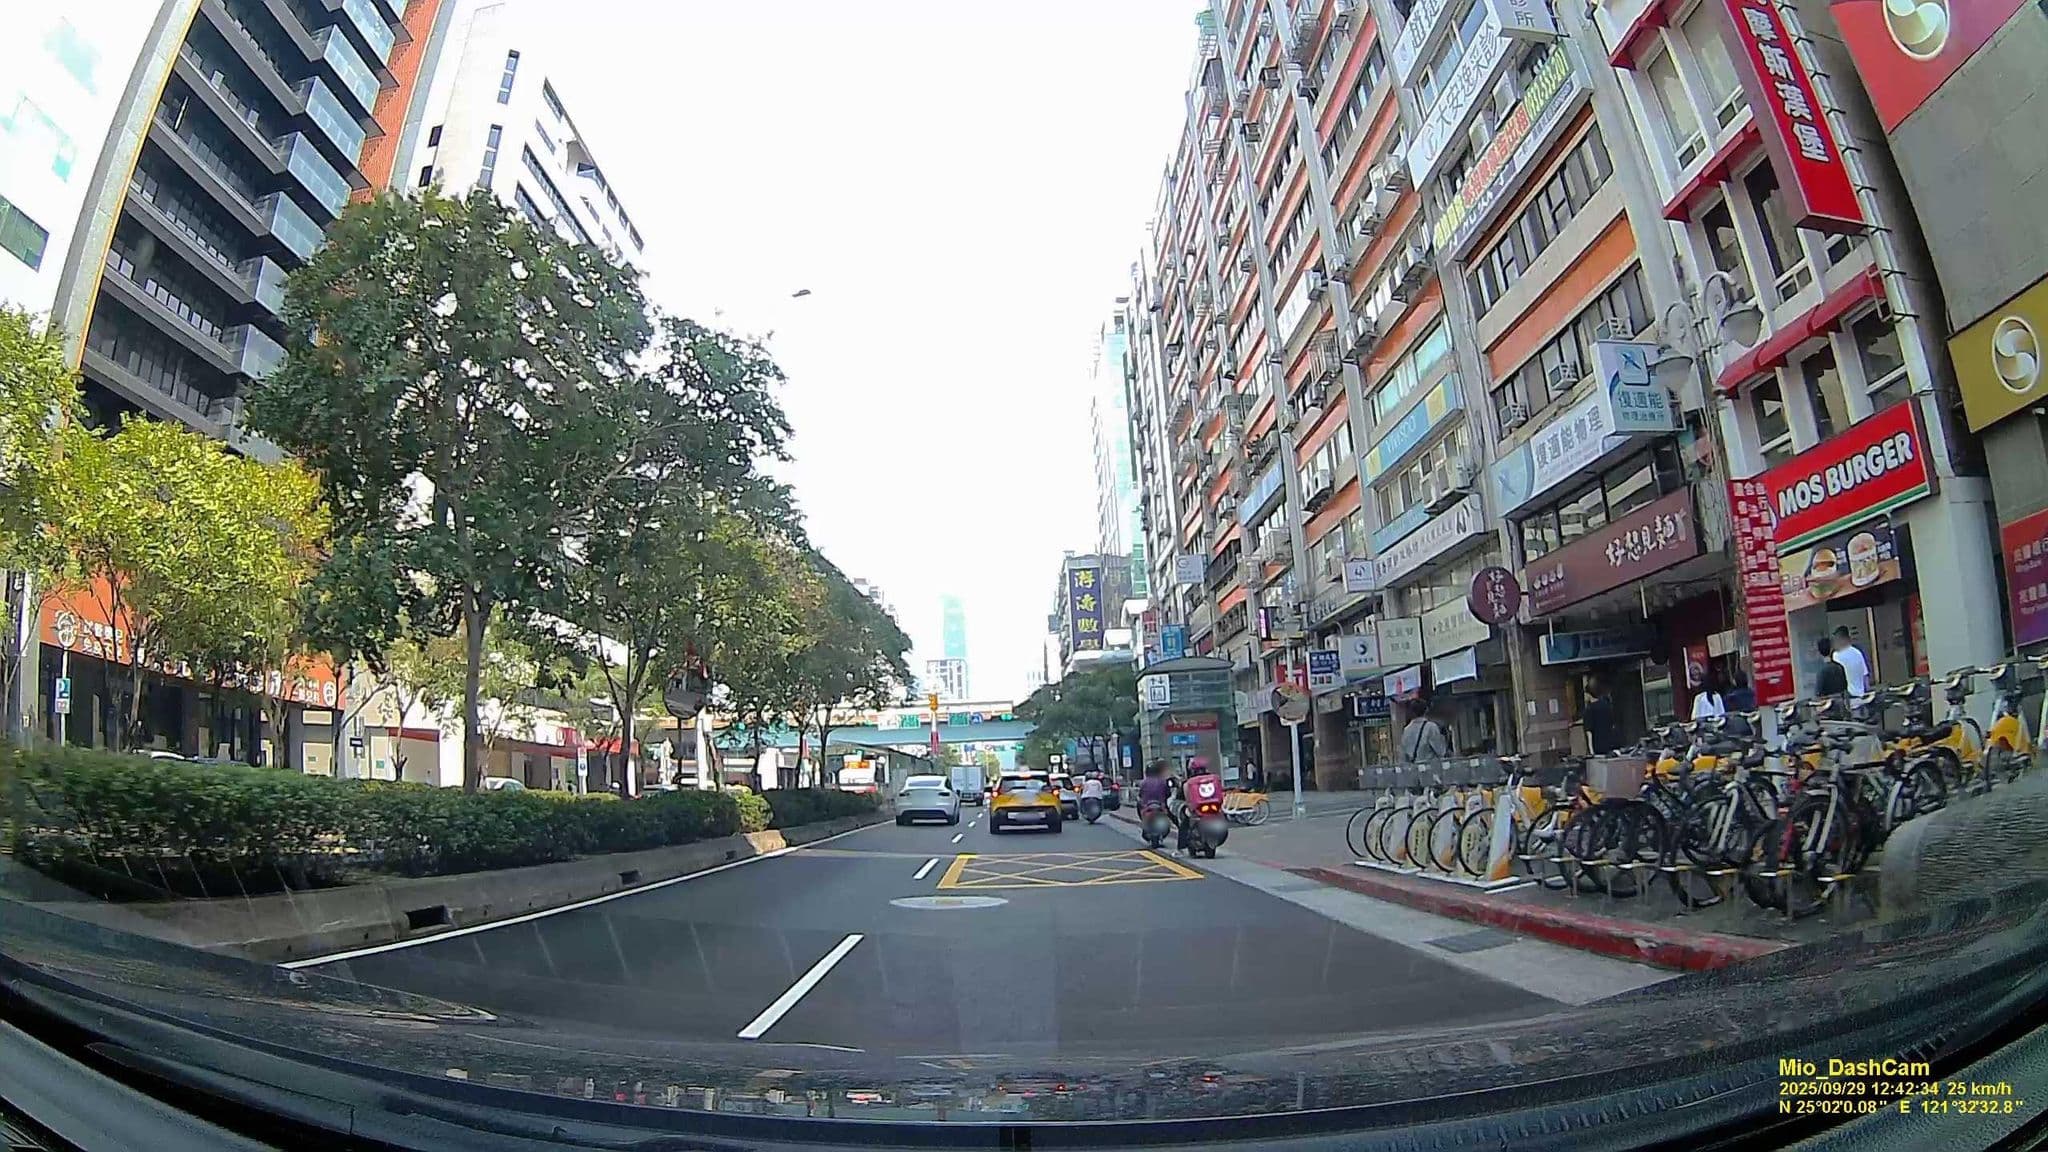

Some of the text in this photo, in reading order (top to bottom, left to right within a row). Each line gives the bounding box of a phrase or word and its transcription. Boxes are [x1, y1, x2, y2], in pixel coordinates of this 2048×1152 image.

[1741, 7, 1831, 163] 摩斯漢堡
[1777, 431, 1914, 518] MOS BURGER
